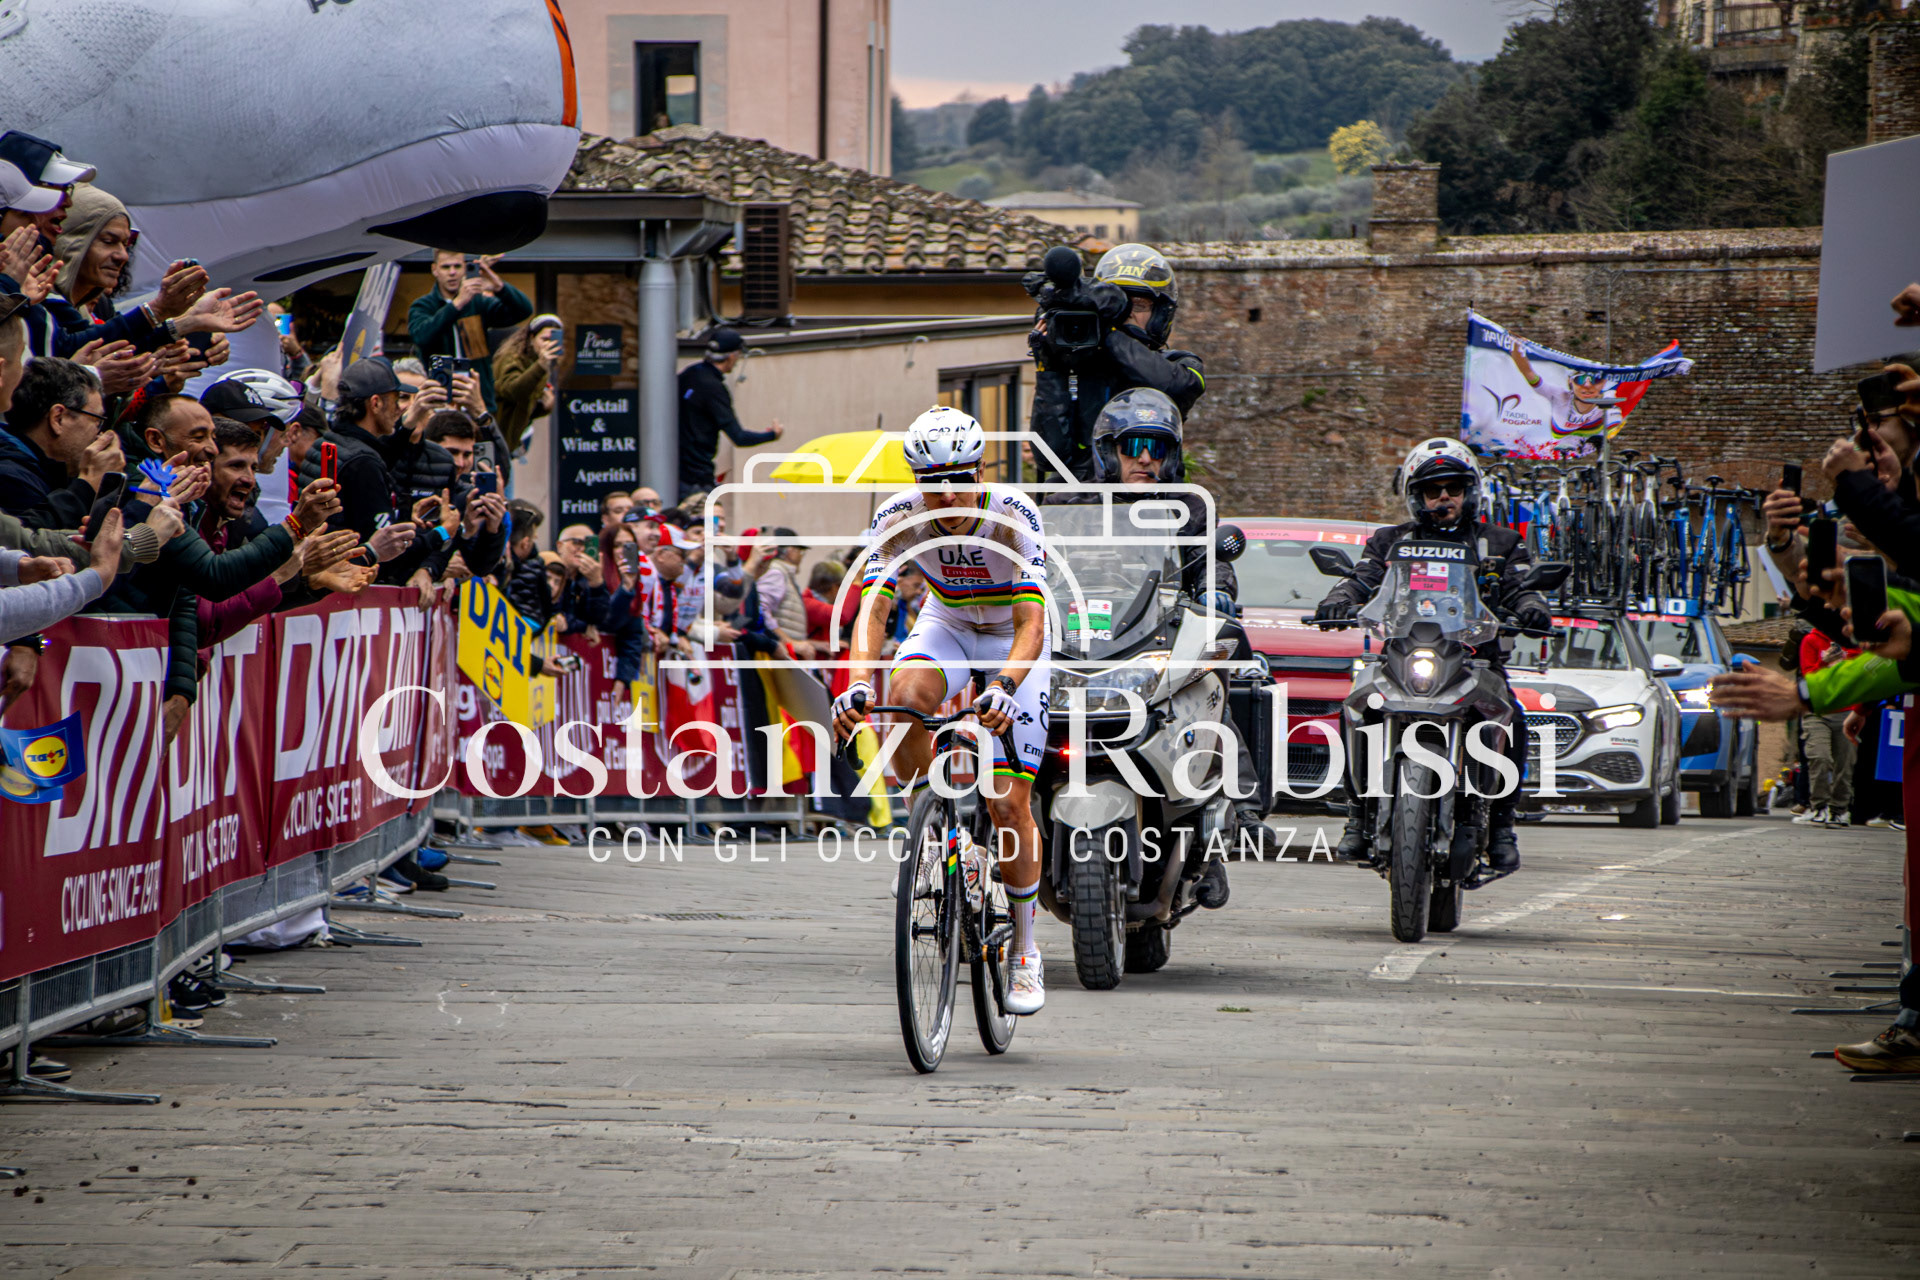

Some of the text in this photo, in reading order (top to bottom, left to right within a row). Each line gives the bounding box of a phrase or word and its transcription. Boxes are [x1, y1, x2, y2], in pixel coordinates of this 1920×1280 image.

[569, 398, 629, 414] Cocktail
[591, 418, 606, 433] &
[562, 437, 636, 452] Wine BAR
[575, 467, 637, 486] Aperitivi
[561, 499, 599, 514] Fritti
[878, 501, 912, 521] Analog
[1011, 498, 1040, 533] Analog
[938, 548, 986, 566] UAE
[1398, 545, 1466, 560] SUZUKI
[469, 576, 527, 677] DAI
[218, 813, 239, 864] 1978
[61, 868, 107, 935] CYCLING
[107, 862, 144, 923] SINCE
